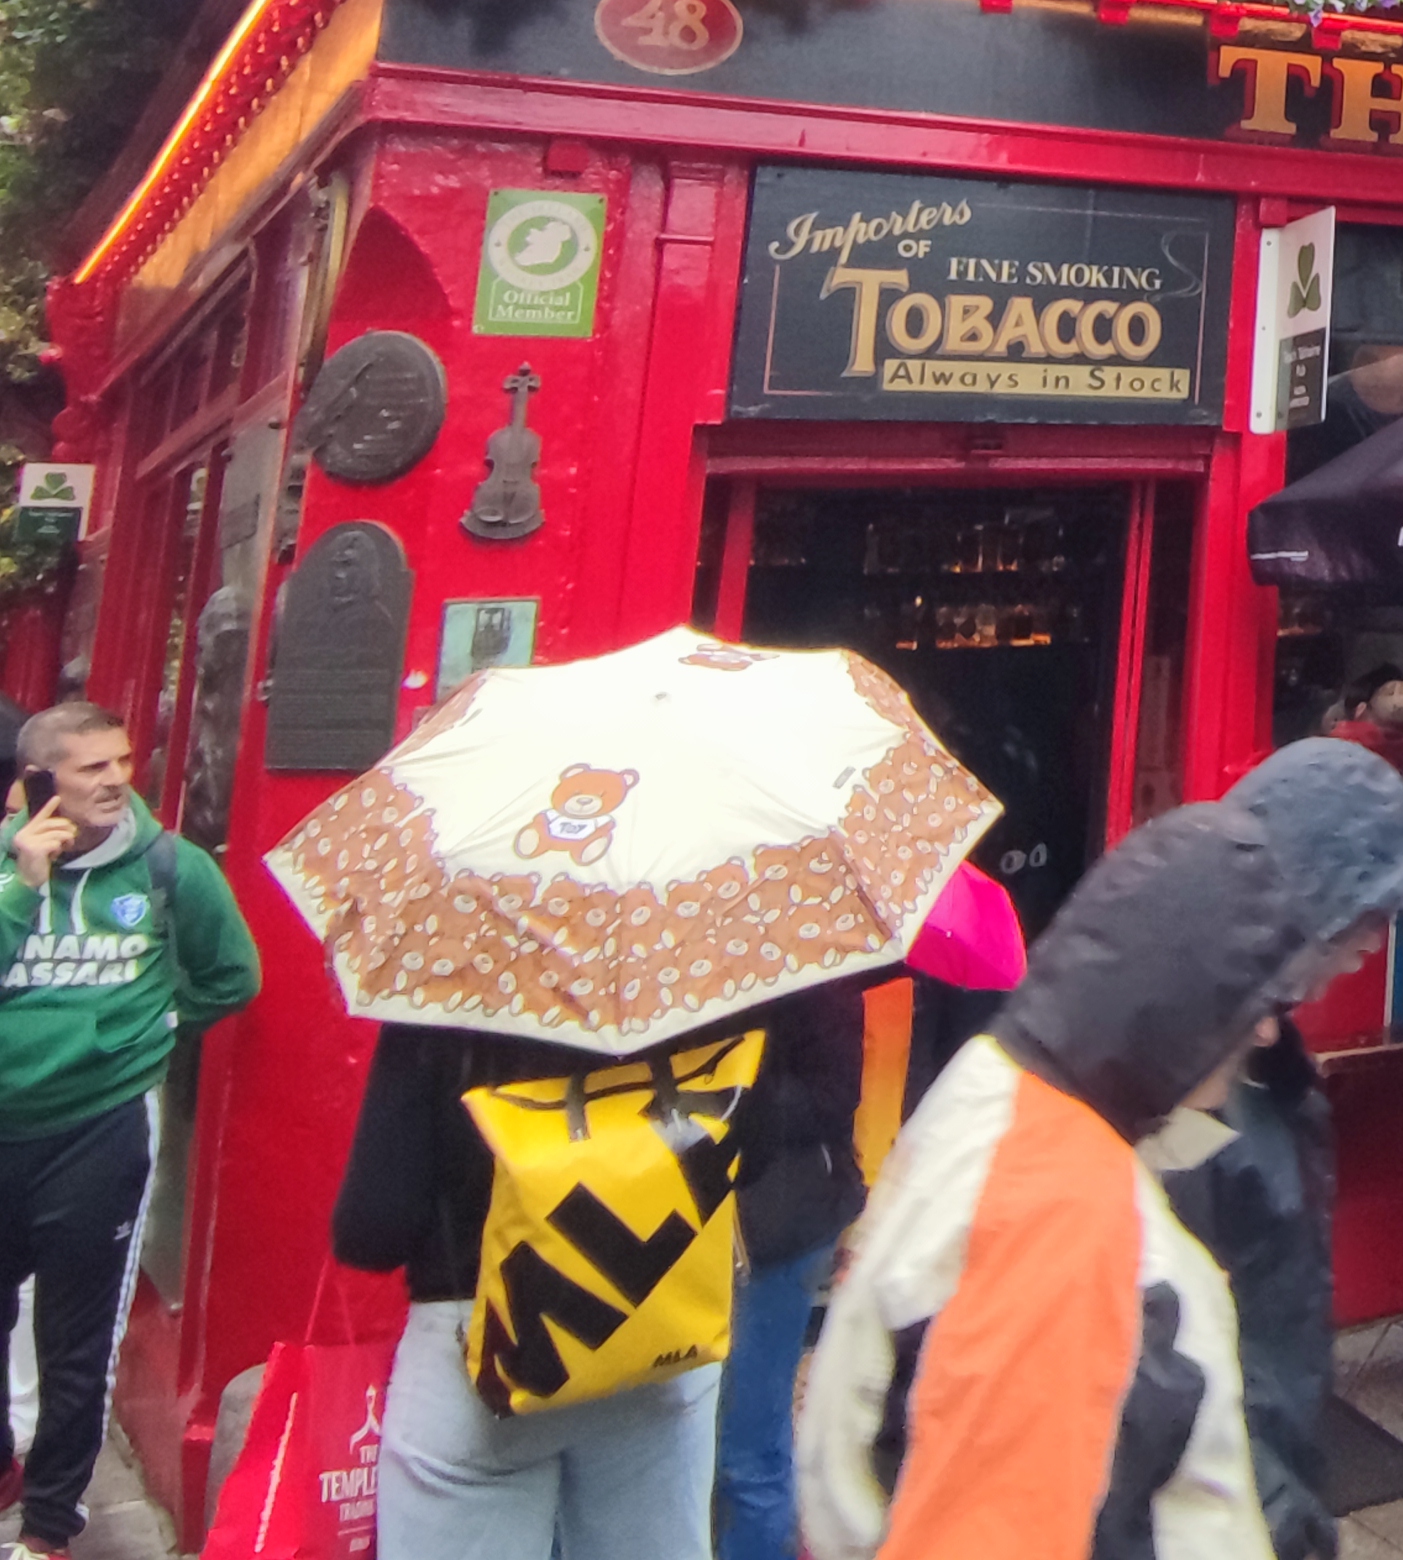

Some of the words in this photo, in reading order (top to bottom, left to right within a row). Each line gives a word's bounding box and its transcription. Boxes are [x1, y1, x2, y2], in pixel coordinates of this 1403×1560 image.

[767, 198, 972, 265] Importers
[897, 239, 933, 259] OF
[947, 257, 1021, 285] FINE
[1025, 260, 1163, 292] SMOKING
[503, 290, 571, 306] Official
[495, 305, 575, 320] Member
[819, 267, 1163, 378] TOBACCO
[888, 361, 1019, 391] Always
[1041, 367, 1070, 390] in
[1088, 368, 1183, 395] Stock
[17, 933, 149, 960] NAMO
[0, 959, 139, 988] ASSARI
[360, 1444, 378, 1464] TH
